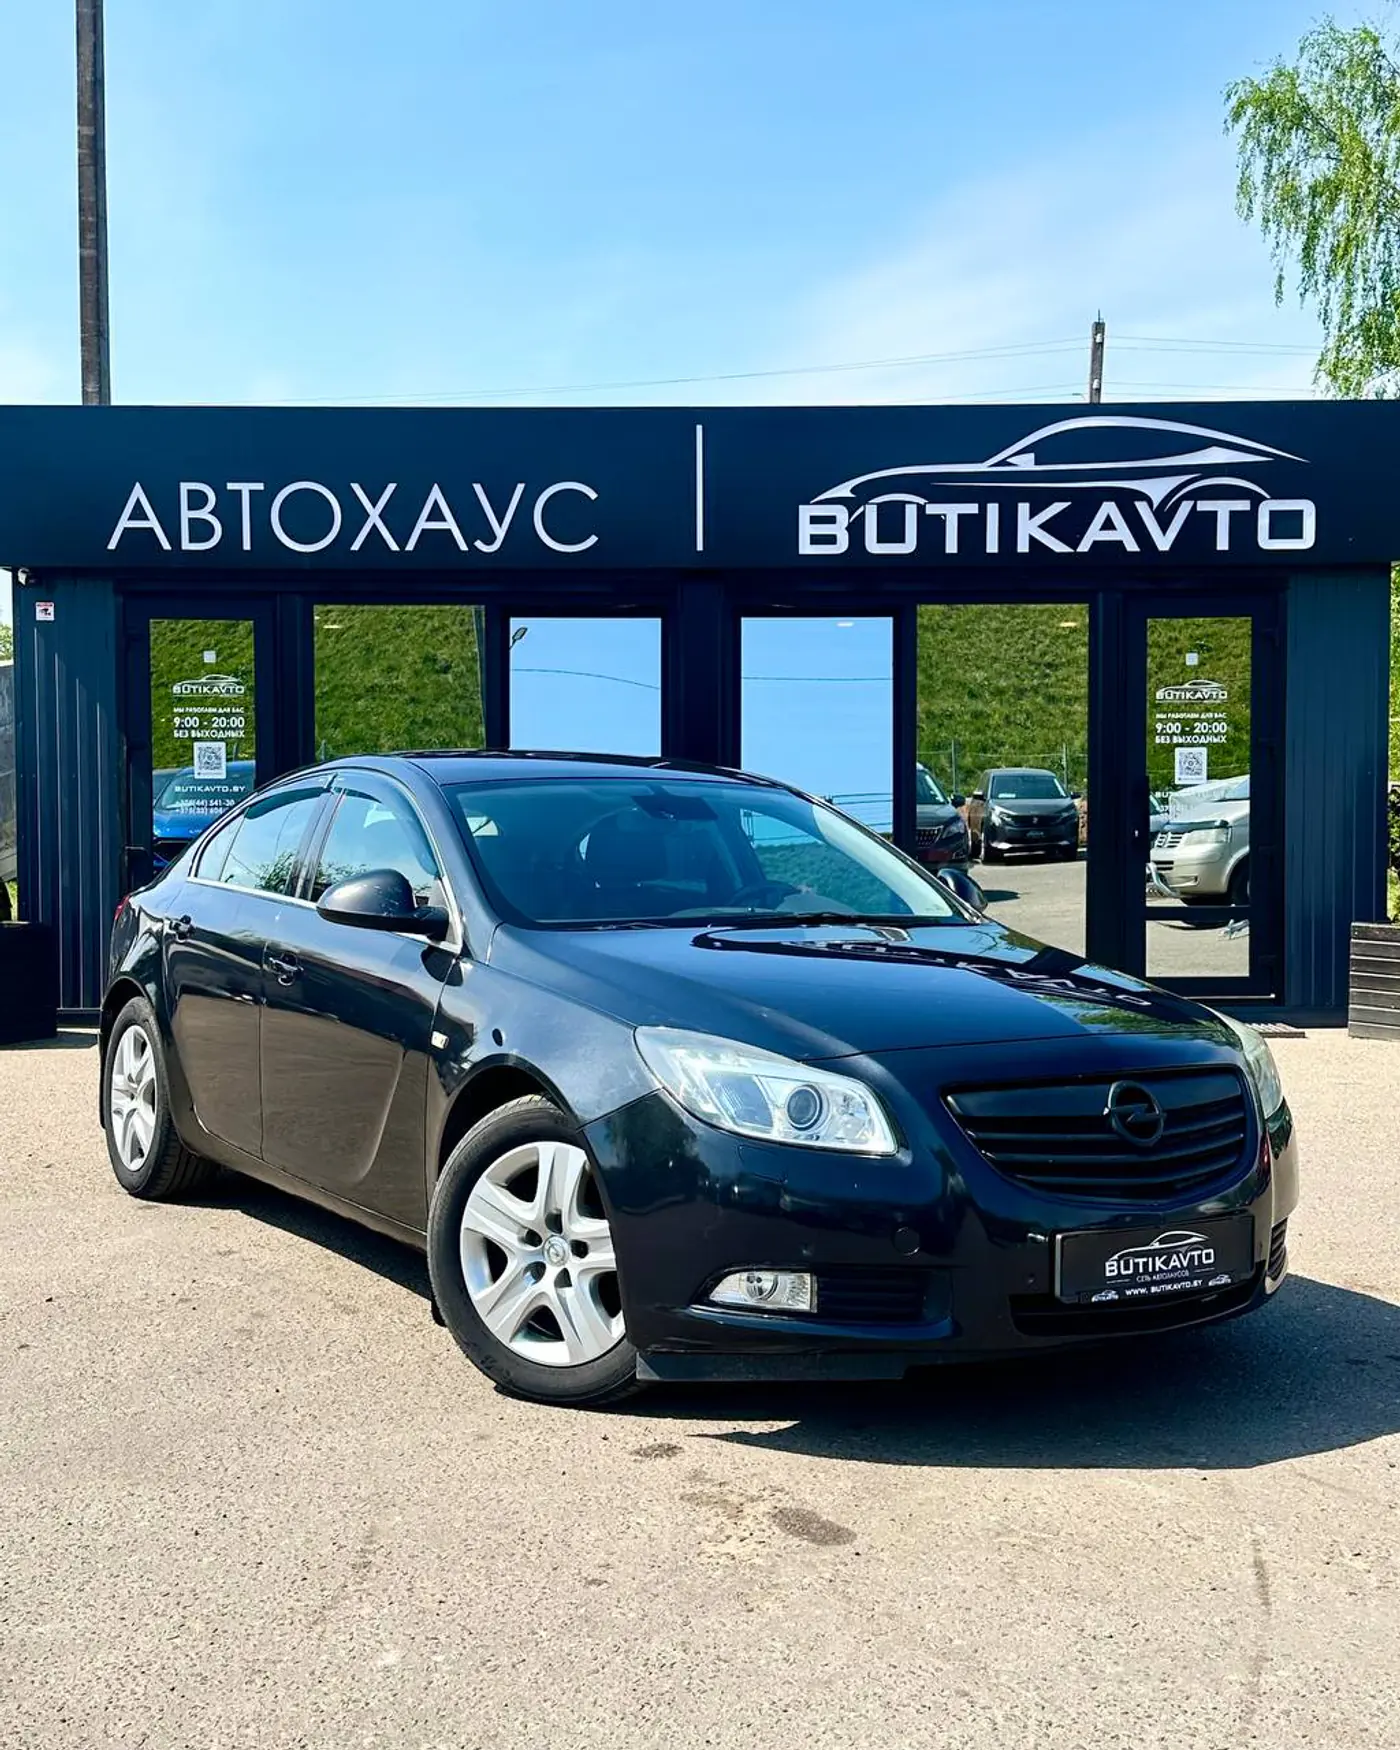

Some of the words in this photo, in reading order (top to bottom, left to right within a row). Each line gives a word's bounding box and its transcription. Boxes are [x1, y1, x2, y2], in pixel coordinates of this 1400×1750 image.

[106, 481, 600, 553] АВТОХАУС
[798, 498, 1316, 555] BUTIKAVTO
[172, 685, 245, 694] BUTIKAVTO
[1155, 690, 1228, 700] BUTIKAVTO
[173, 716, 200, 728] 9:00
[211, 716, 245, 728] 20:00
[1155, 722, 1181, 733] 9:00
[1193, 722, 1227, 733] 20:00
[173, 729, 189, 738] БЕЗ
[190, 729, 245, 739] ВЫХОДНЫХ
[1155, 735, 1171, 744] БЕЗ
[1172, 735, 1227, 744] ВЫХОДНЫХ
[174, 785, 246, 793] BUTIKAVTO.BY
[1104, 1248, 1215, 1277] BUTIKAVTO
[1150, 1279, 1203, 1293] BUTIKAVTO.BY
